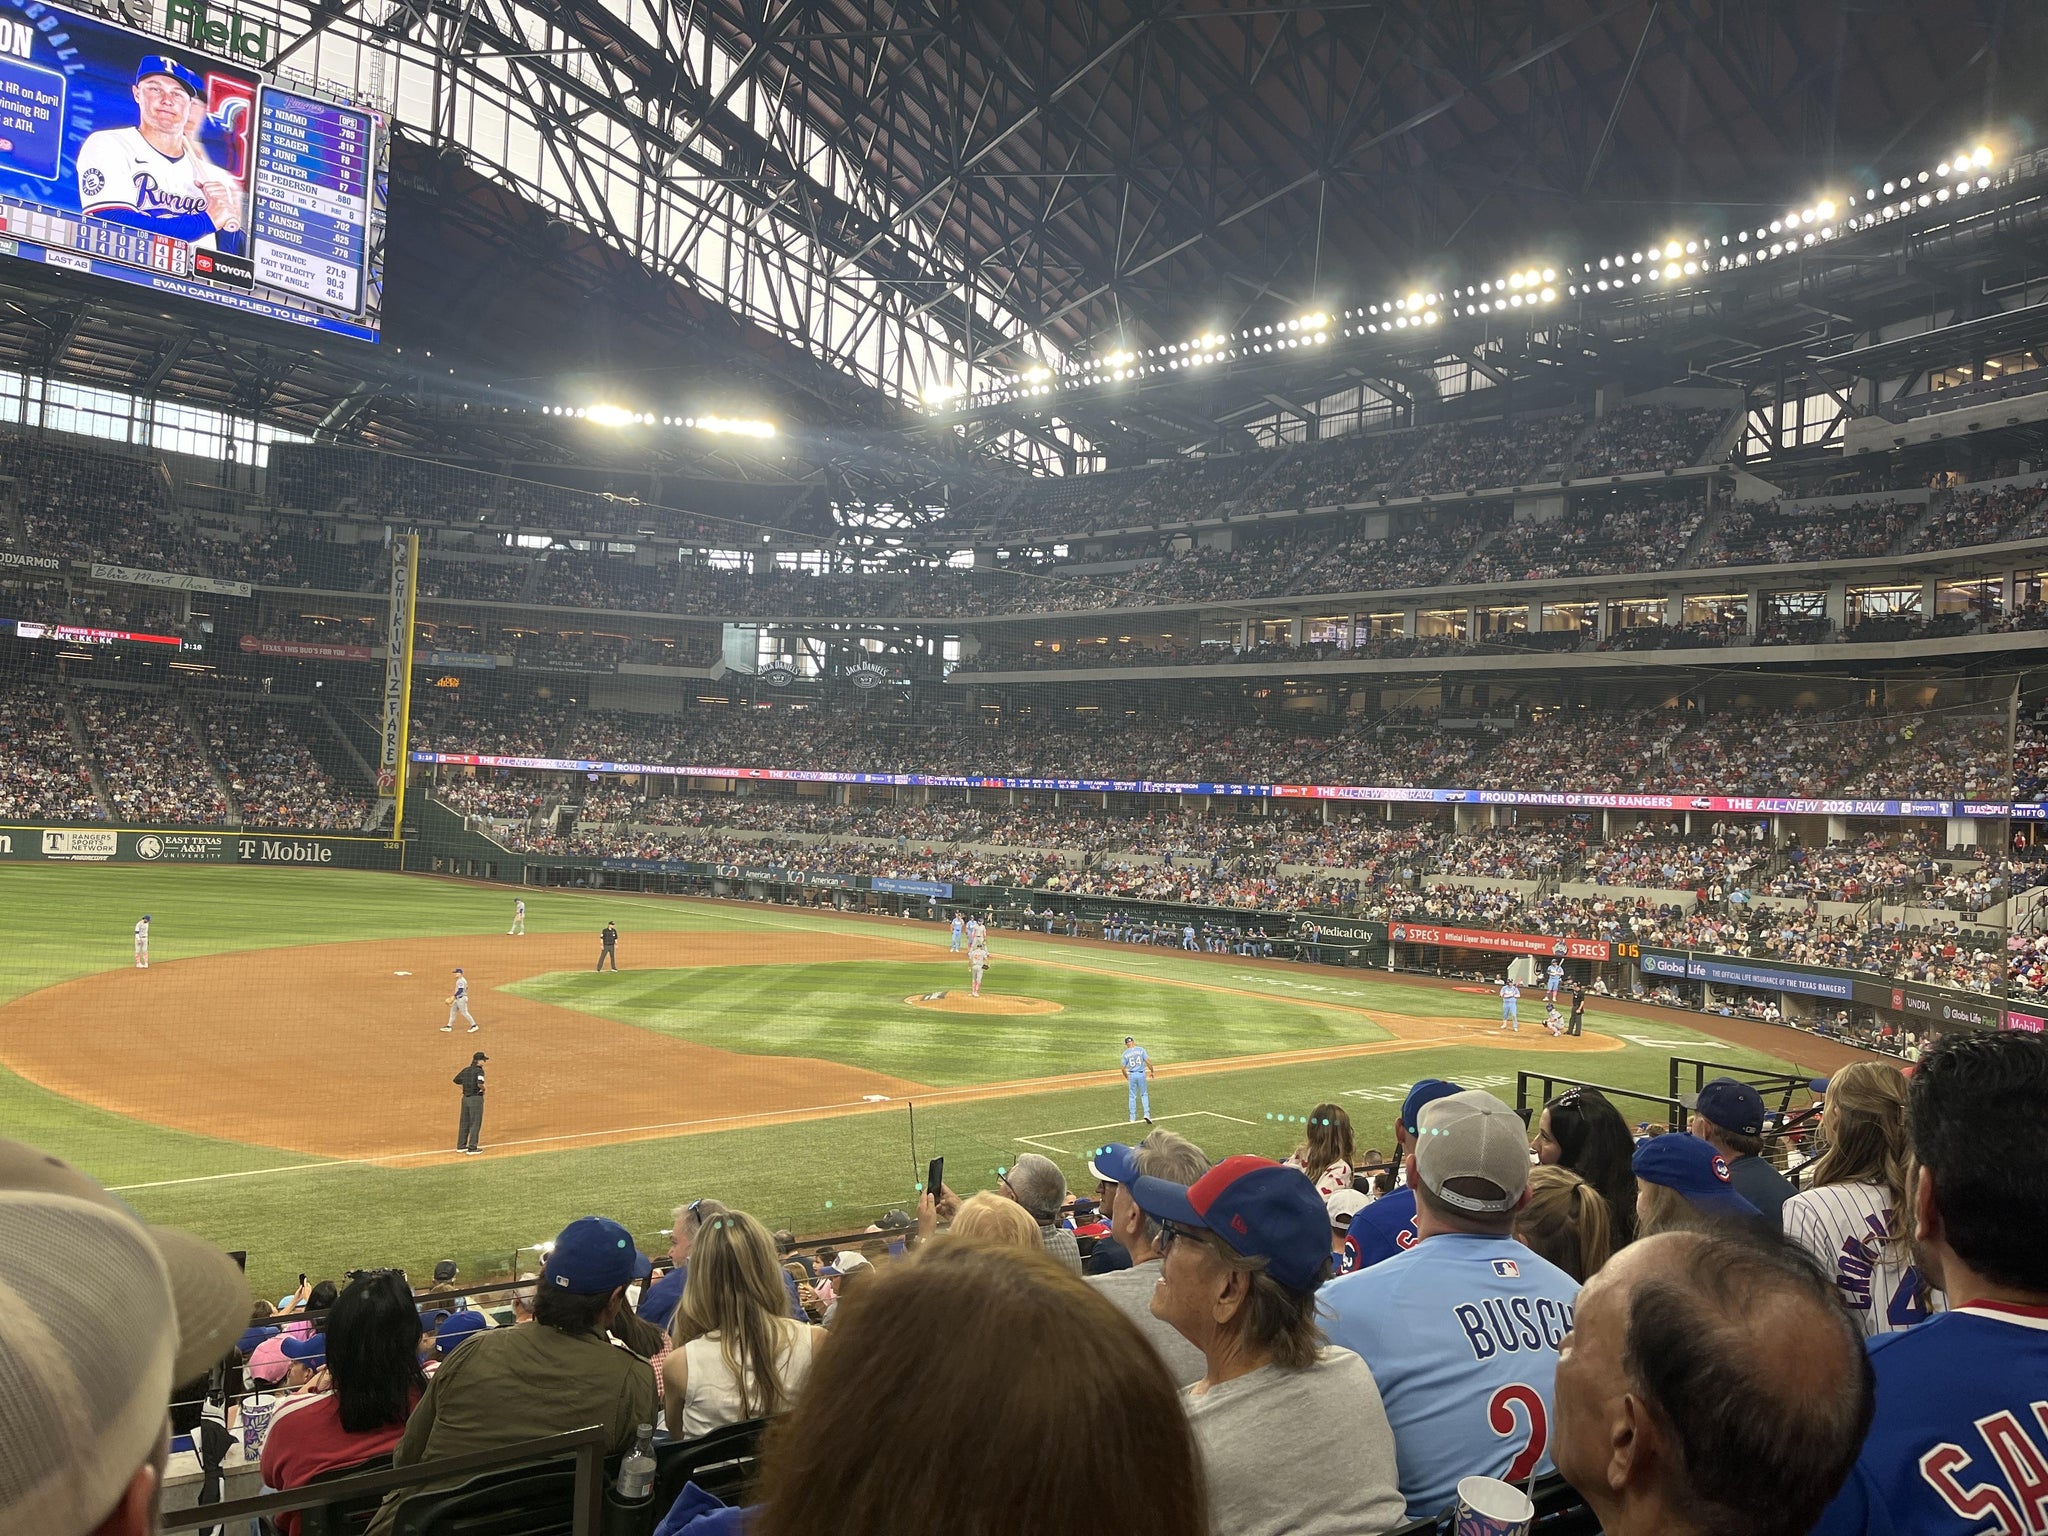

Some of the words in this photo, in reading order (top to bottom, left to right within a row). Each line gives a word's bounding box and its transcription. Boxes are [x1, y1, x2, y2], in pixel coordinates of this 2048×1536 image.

[165, 0, 268, 62] Field
[5, 81, 19, 95] HR
[21, 89, 34, 101] on
[36, 90, 59, 107] April
[33, 106, 50, 120] RBI
[3, 116, 14, 128] at
[15, 117, 35, 134] ATH.
[263, 107, 273, 116] RF
[275, 109, 308, 126] NIMMO
[339, 129, 356, 140] .785
[262, 120, 272, 129] 2B
[274, 122, 305, 139] DURAN
[338, 142, 355, 153] .818
[261, 133, 271, 142] SS
[273, 134, 309, 154] SEAGER
[341, 155, 350, 165] F8
[260, 146, 271, 155] 3B
[273, 147, 297, 163] JUNG
[340, 169, 350, 179] 1B
[259, 159, 269, 168] CF
[272, 161, 308, 180] CARTER
[339, 183, 348, 192] F7
[258, 172, 268, 180] DH
[271, 174, 318, 195] PEDERSON
[335, 195, 351, 206] .680
[269, 187, 285, 199] .233
[311, 200, 317, 209] 2
[349, 211, 354, 220] 8
[257, 197, 267, 207] LF
[269, 200, 299, 217] OSUNA
[333, 220, 350, 232] .702
[258, 211, 264, 220] C
[268, 213, 305, 232] JANSEN
[332, 234, 349, 245] .625
[81, 224, 87, 236] 0
[101, 231, 107, 241] 2
[120, 235, 126, 246] 0
[139, 241, 145, 250] 2
[159, 246, 165, 255] 4
[176, 250, 182, 259] 2
[256, 223, 264, 233] 1B
[267, 226, 303, 245] FOSCUE
[332, 247, 349, 259] .778
[48, 254, 72, 266] LAST
[74, 261, 88, 269] AB
[99, 243, 105, 254] 4
[119, 248, 125, 258] 0
[138, 252, 144, 263] 4
[159, 258, 165, 267] 4
[176, 262, 182, 272] 2
[271, 248, 307, 266] DISTANCE
[326, 265, 347, 279] 271.9
[214, 262, 252, 279] TOYOTA
[260, 257, 278, 268] EXIT
[279, 261, 316, 280] VELOCITY
[326, 277, 345, 290] 90.3
[265, 269, 283, 281] EXIT
[284, 275, 310, 289] ANGLE
[326, 288, 344, 301] 45.6
[153, 278, 187, 294] EVAN
[188, 287, 237, 306] CARTER
[239, 298, 272, 314] FLIED
[273, 307, 291, 318] TO
[292, 311, 319, 327] LEFT
[60, 627, 88, 636] RANGERS
[284, 645, 298, 654] THIS
[332, 648, 345, 656] YOU
[845, 665, 861, 677] JACK
[386, 702, 397, 761] FARE
[478, 756, 495, 765] THE
[497, 756, 535, 767] ALL-NEW
[614, 763, 640, 772] PROUD
[642, 765, 675, 774] PARTNER
[676, 766, 686, 774] OF
[687, 766, 707, 775] TEXAS
[707, 768, 739, 777] RANGERS
[768, 770, 783, 778] THE
[784, 770, 817, 780] ALL-NEW
[820, 772, 837, 780] 2026
[838, 773, 856, 782] RAV4
[1316, 787, 1335, 797] THE
[1338, 788, 1381, 799] ALL-NEW
[1408, 790, 1434, 800] RAV4
[1480, 792, 1516, 802] PROUD
[1518, 794, 1565, 804] PARTNER
[1566, 794, 1581, 804] OF
[1582, 795, 1616, 806] TEXAS
[1618, 796, 1673, 807] RANGERS
[1727, 798, 1753, 810] THE
[1756, 800, 1818, 812] ALL-NEW
[1822, 801, 1852, 813] 2026
[1855, 801, 1885, 813] RAV4
[1964, 805, 1985, 814] TEXAS
[46, 833, 64, 850] T
[165, 836, 190, 844] EAST
[192, 837, 222, 845] TEXAS
[180, 844, 206, 853] A&M
[383, 842, 400, 850] 326
[261, 840, 332, 863] Mobile
[745, 869, 771, 880] American
[810, 875, 838, 886] American
[1317, 925, 1353, 938] Medical
[1353, 928, 1373, 943] City
[1409, 928, 1440, 941] SPEC'S
[1445, 933, 1463, 942] Official
[1463, 935, 1479, 944] Liquor
[1479, 936, 1493, 945] Store
[1494, 937, 1500, 945] of
[1500, 938, 1509, 946] the
[1510, 938, 1524, 947] Texas
[1525, 940, 1546, 950] Rangers
[1572, 943, 1606, 957] SPEC'S
[1628, 944, 1640, 958] 15
[1657, 959, 1685, 973] Globe
[1688, 964, 1706, 976] Life
[1712, 969, 1721, 978] THE
[1721, 970, 1741, 980] OFFICIAL
[1742, 973, 1751, 981] LIFE
[1752, 974, 1779, 986] INSURANCE
[1779, 978, 1785, 986] OF
[1786, 979, 1798, 988] THE
[1799, 980, 1817, 991] TEXAS
[1818, 983, 1846, 994] RANGERS
[1952, 1008, 1969, 1022] Globe
[1970, 1012, 1982, 1025] Life
[1982, 1015, 1997, 1028] Field
[2010, 1017, 2042, 1033] Mobile
[1129, 1055, 1142, 1067] 64
[1487, 1383, 1547, 1481] 2
[1919, 1400, 2048, 1536] SA
